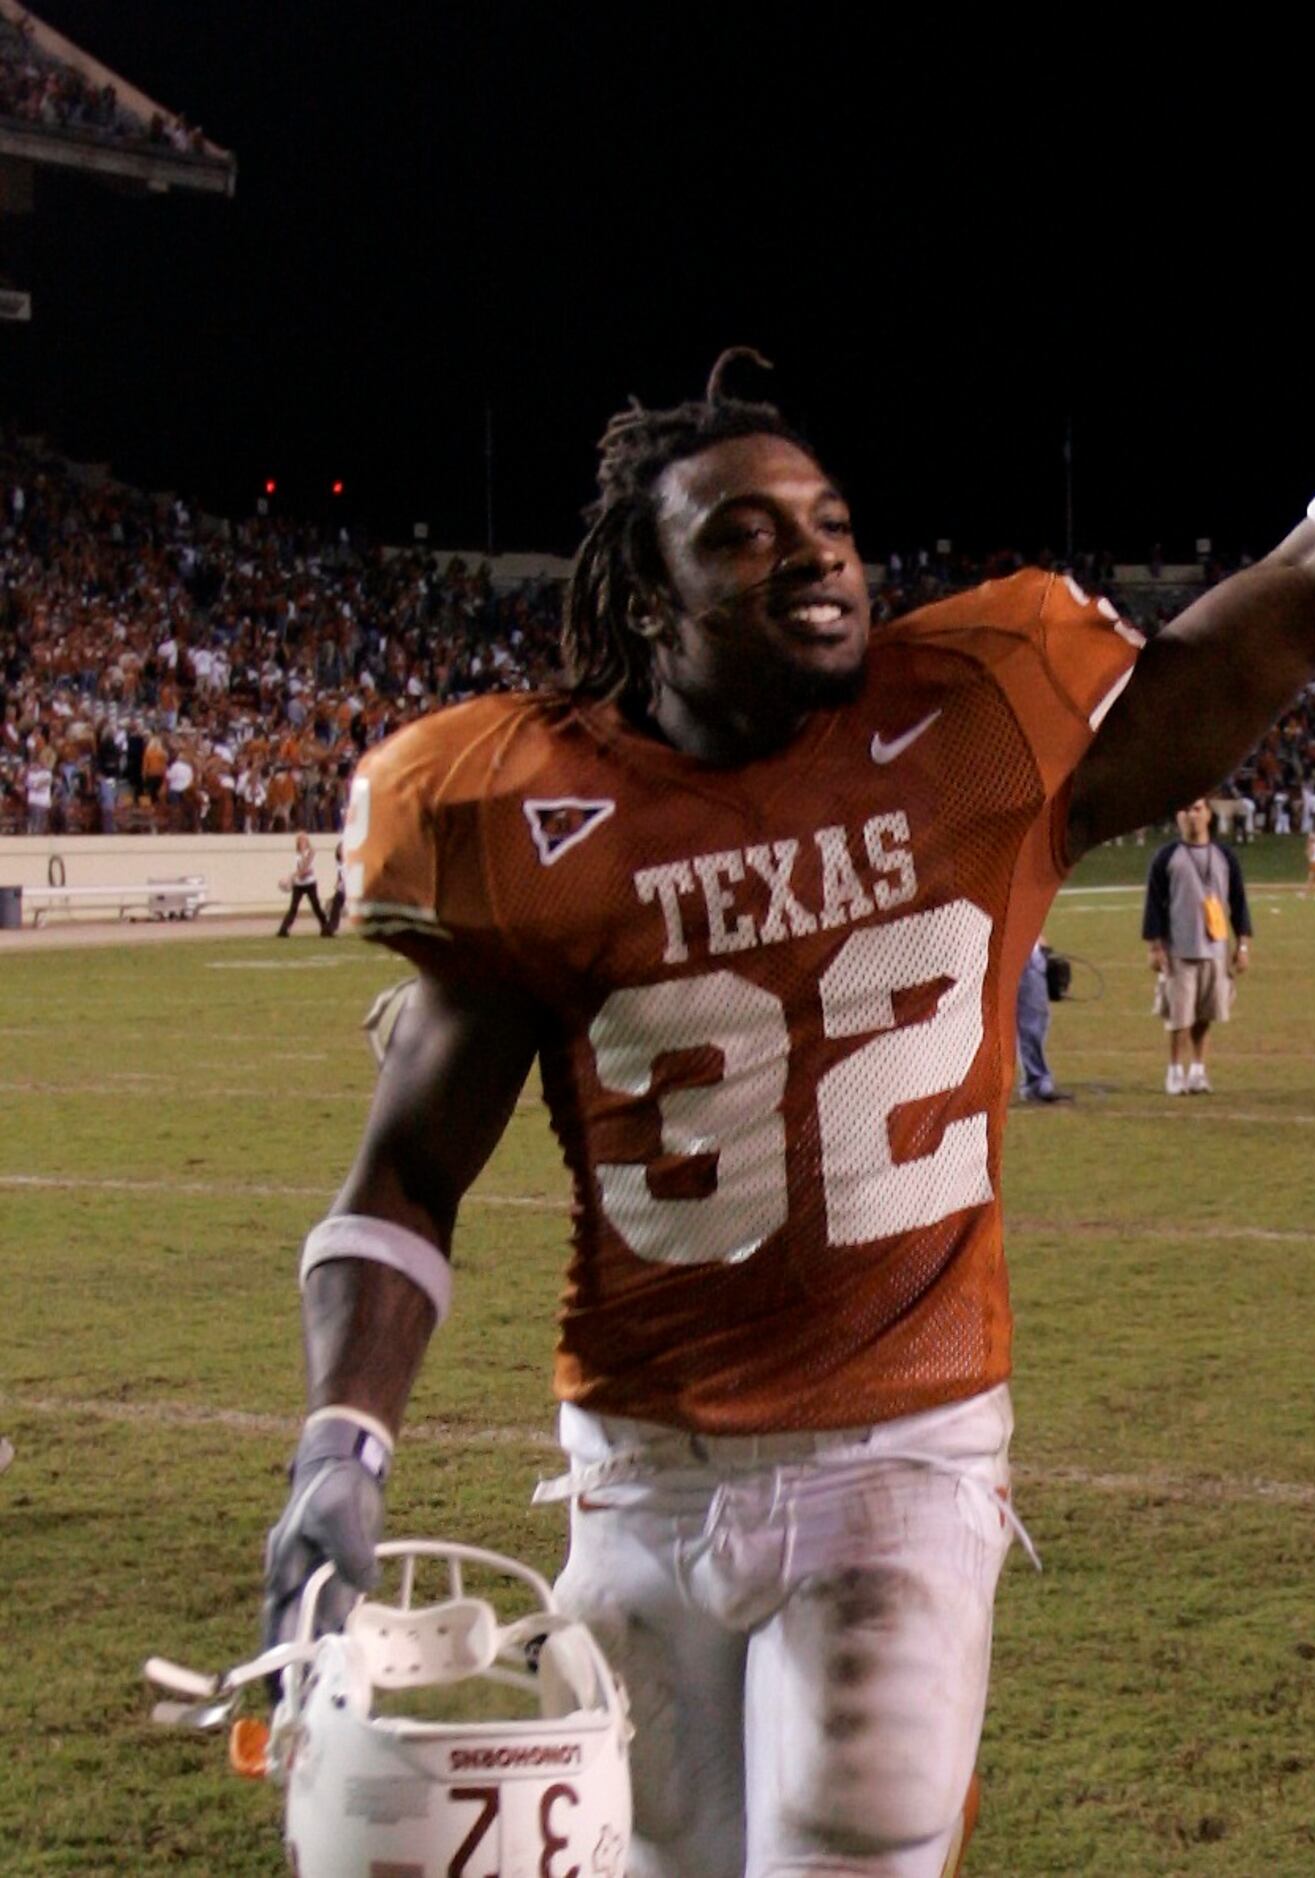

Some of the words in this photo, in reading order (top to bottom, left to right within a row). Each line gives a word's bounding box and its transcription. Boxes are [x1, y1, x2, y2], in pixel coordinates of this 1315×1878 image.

[635, 810, 917, 961] TEXAS
[589, 899, 995, 1265] 32
[450, 1743, 581, 1771] LONGHORNS
